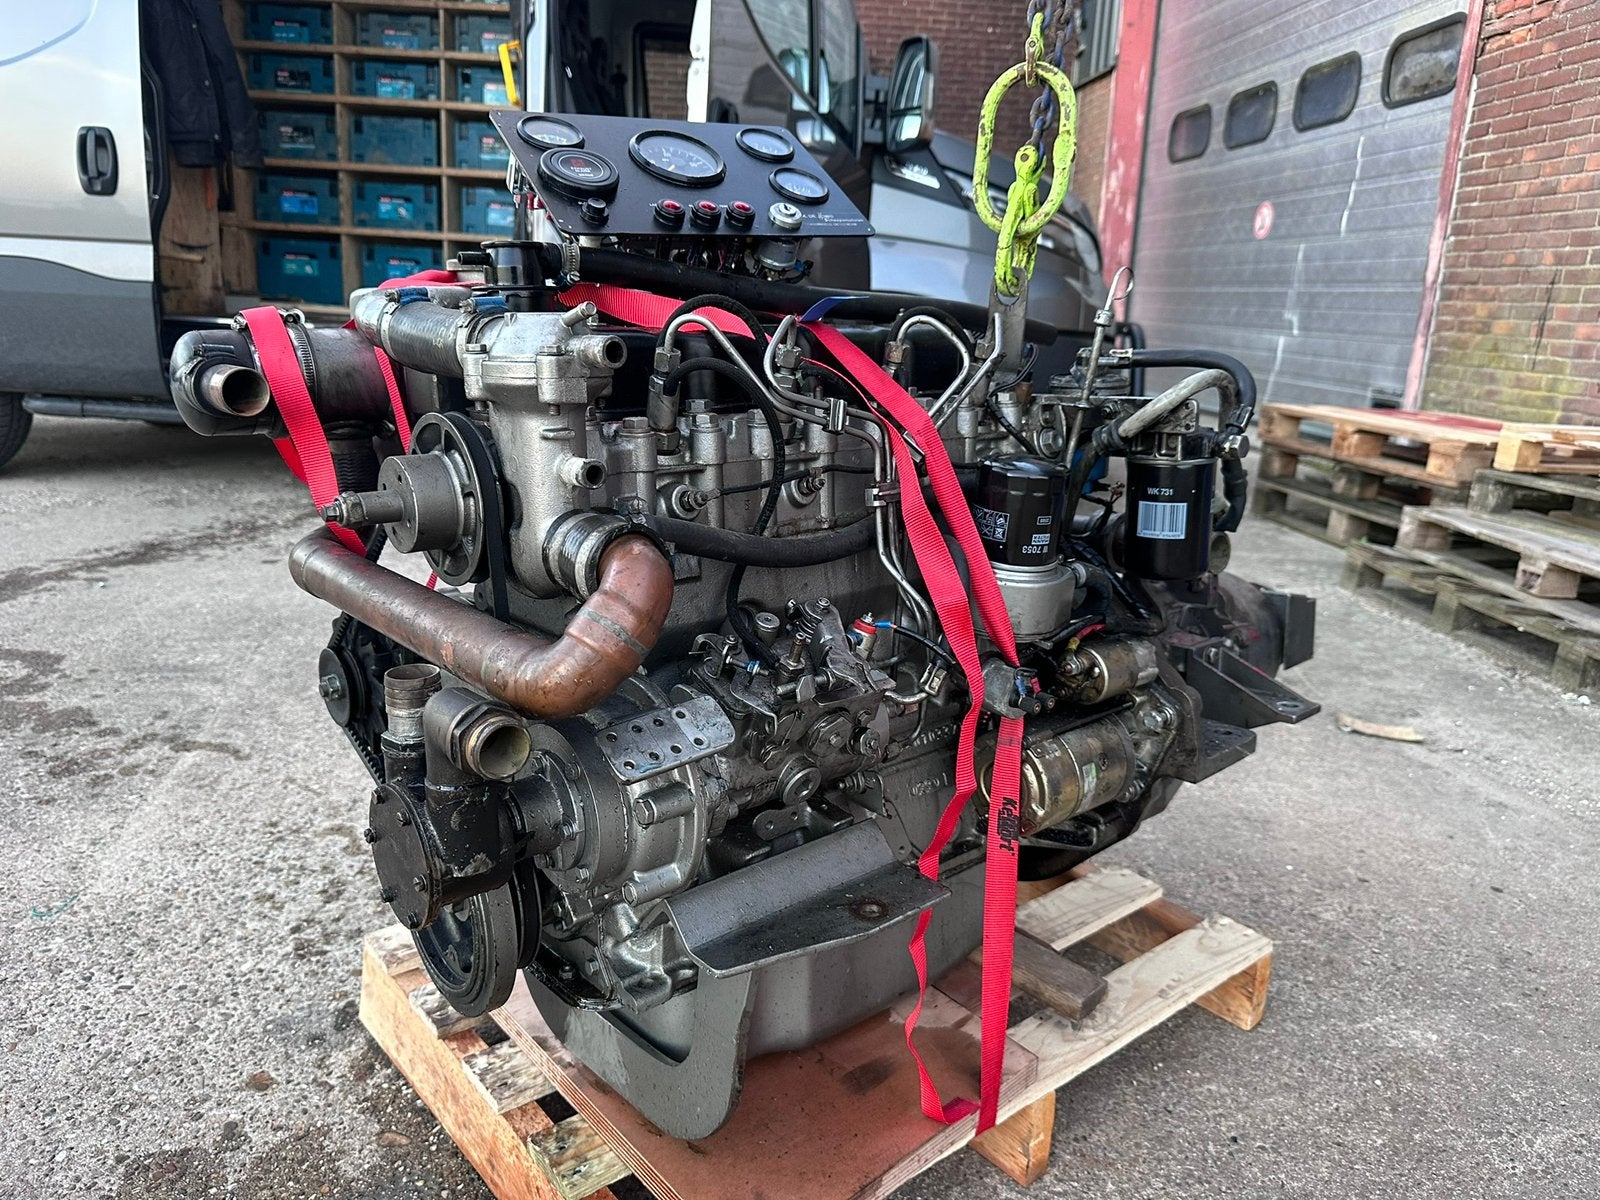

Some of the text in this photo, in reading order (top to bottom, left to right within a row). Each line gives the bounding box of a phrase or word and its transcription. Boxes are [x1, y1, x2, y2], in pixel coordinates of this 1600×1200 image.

[1147, 487, 1174, 496] WK 731
[1022, 545, 1042, 554] 7053
